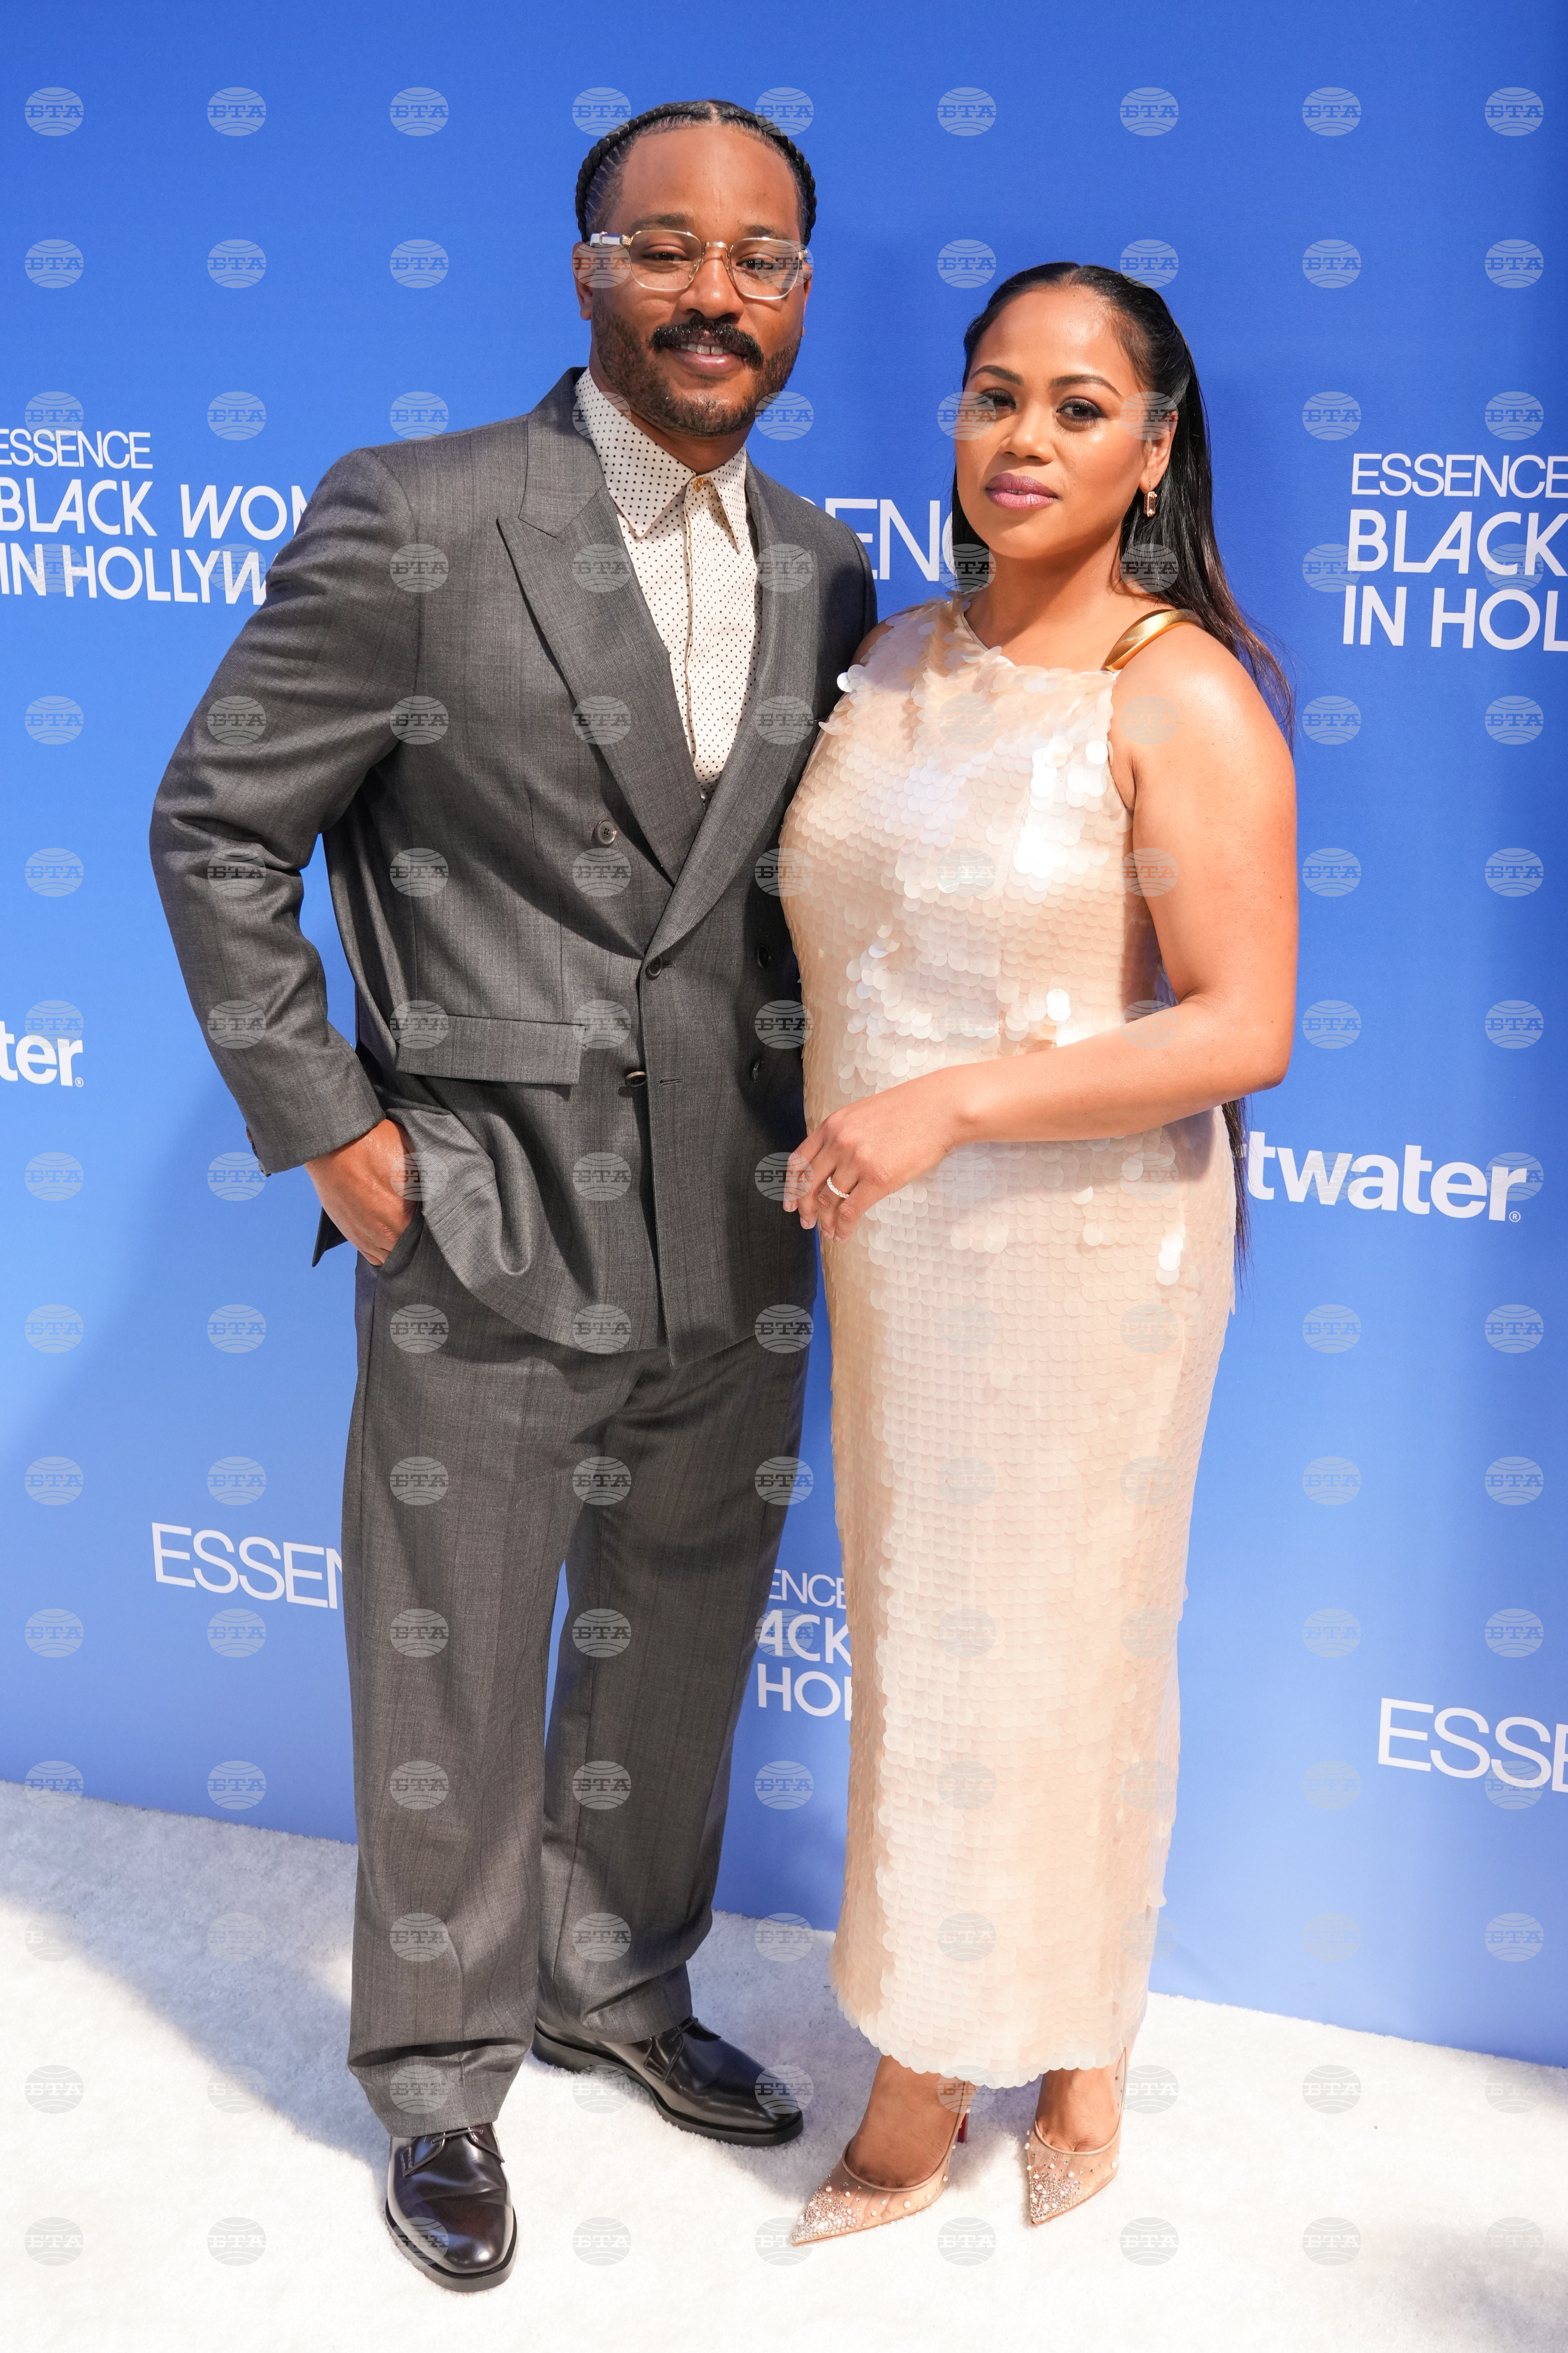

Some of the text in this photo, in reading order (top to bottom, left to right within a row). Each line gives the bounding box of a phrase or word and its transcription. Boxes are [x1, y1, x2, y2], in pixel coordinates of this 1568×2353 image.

[0, 477, 158, 537] BLACK
[1351, 453, 1568, 498] ESSENCE
[0, 542, 47, 596] IN
[799, 496, 958, 582] EN
[1347, 509, 1568, 577] BLACK
[1342, 585, 1568, 652] IN HOL
